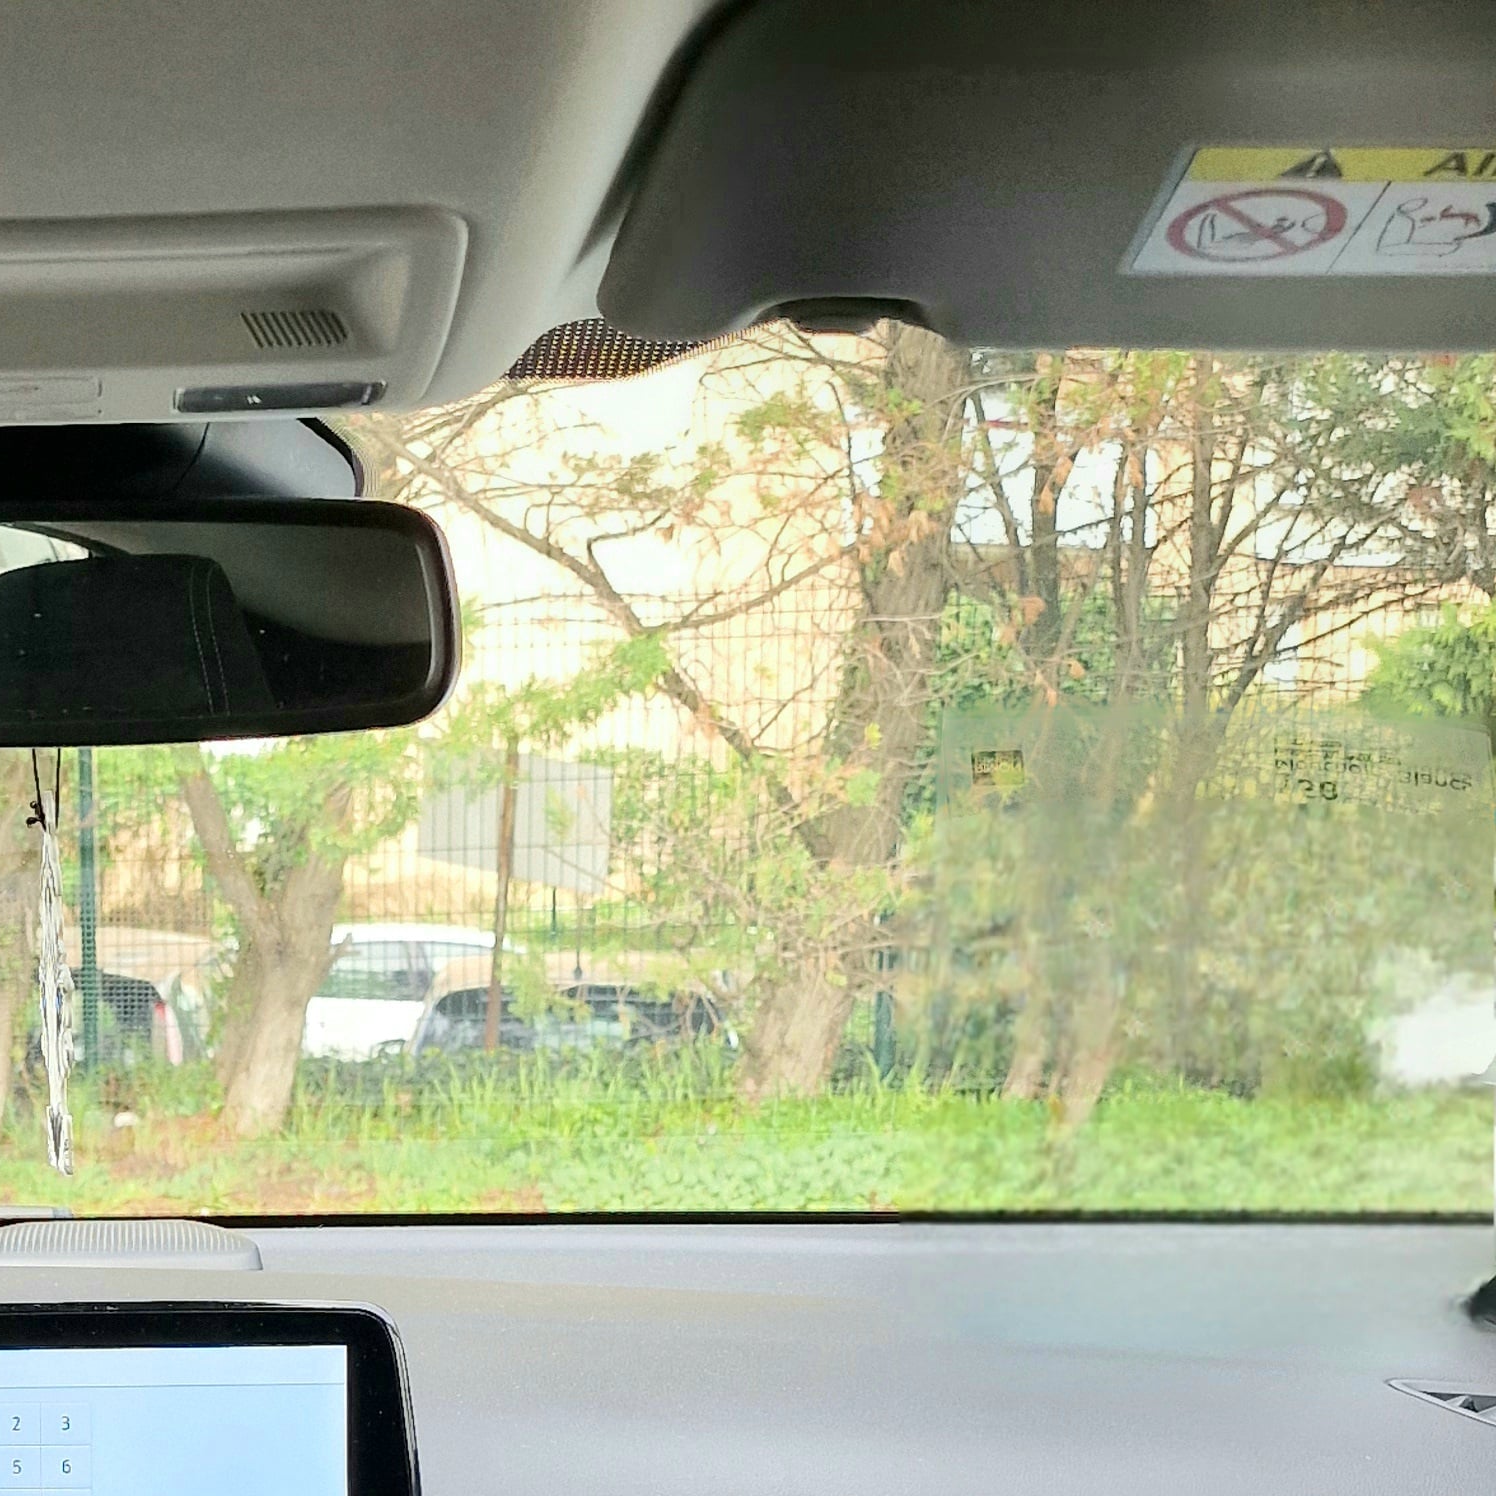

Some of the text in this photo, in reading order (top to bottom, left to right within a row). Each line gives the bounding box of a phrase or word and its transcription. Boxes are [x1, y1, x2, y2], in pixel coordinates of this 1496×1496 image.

[1423, 151, 1496, 176] AI
[12, 1416, 21, 1431] 2
[61, 1415, 70, 1431] 3
[12, 1459, 22, 1474] 5
[62, 1459, 71, 1474] 6
